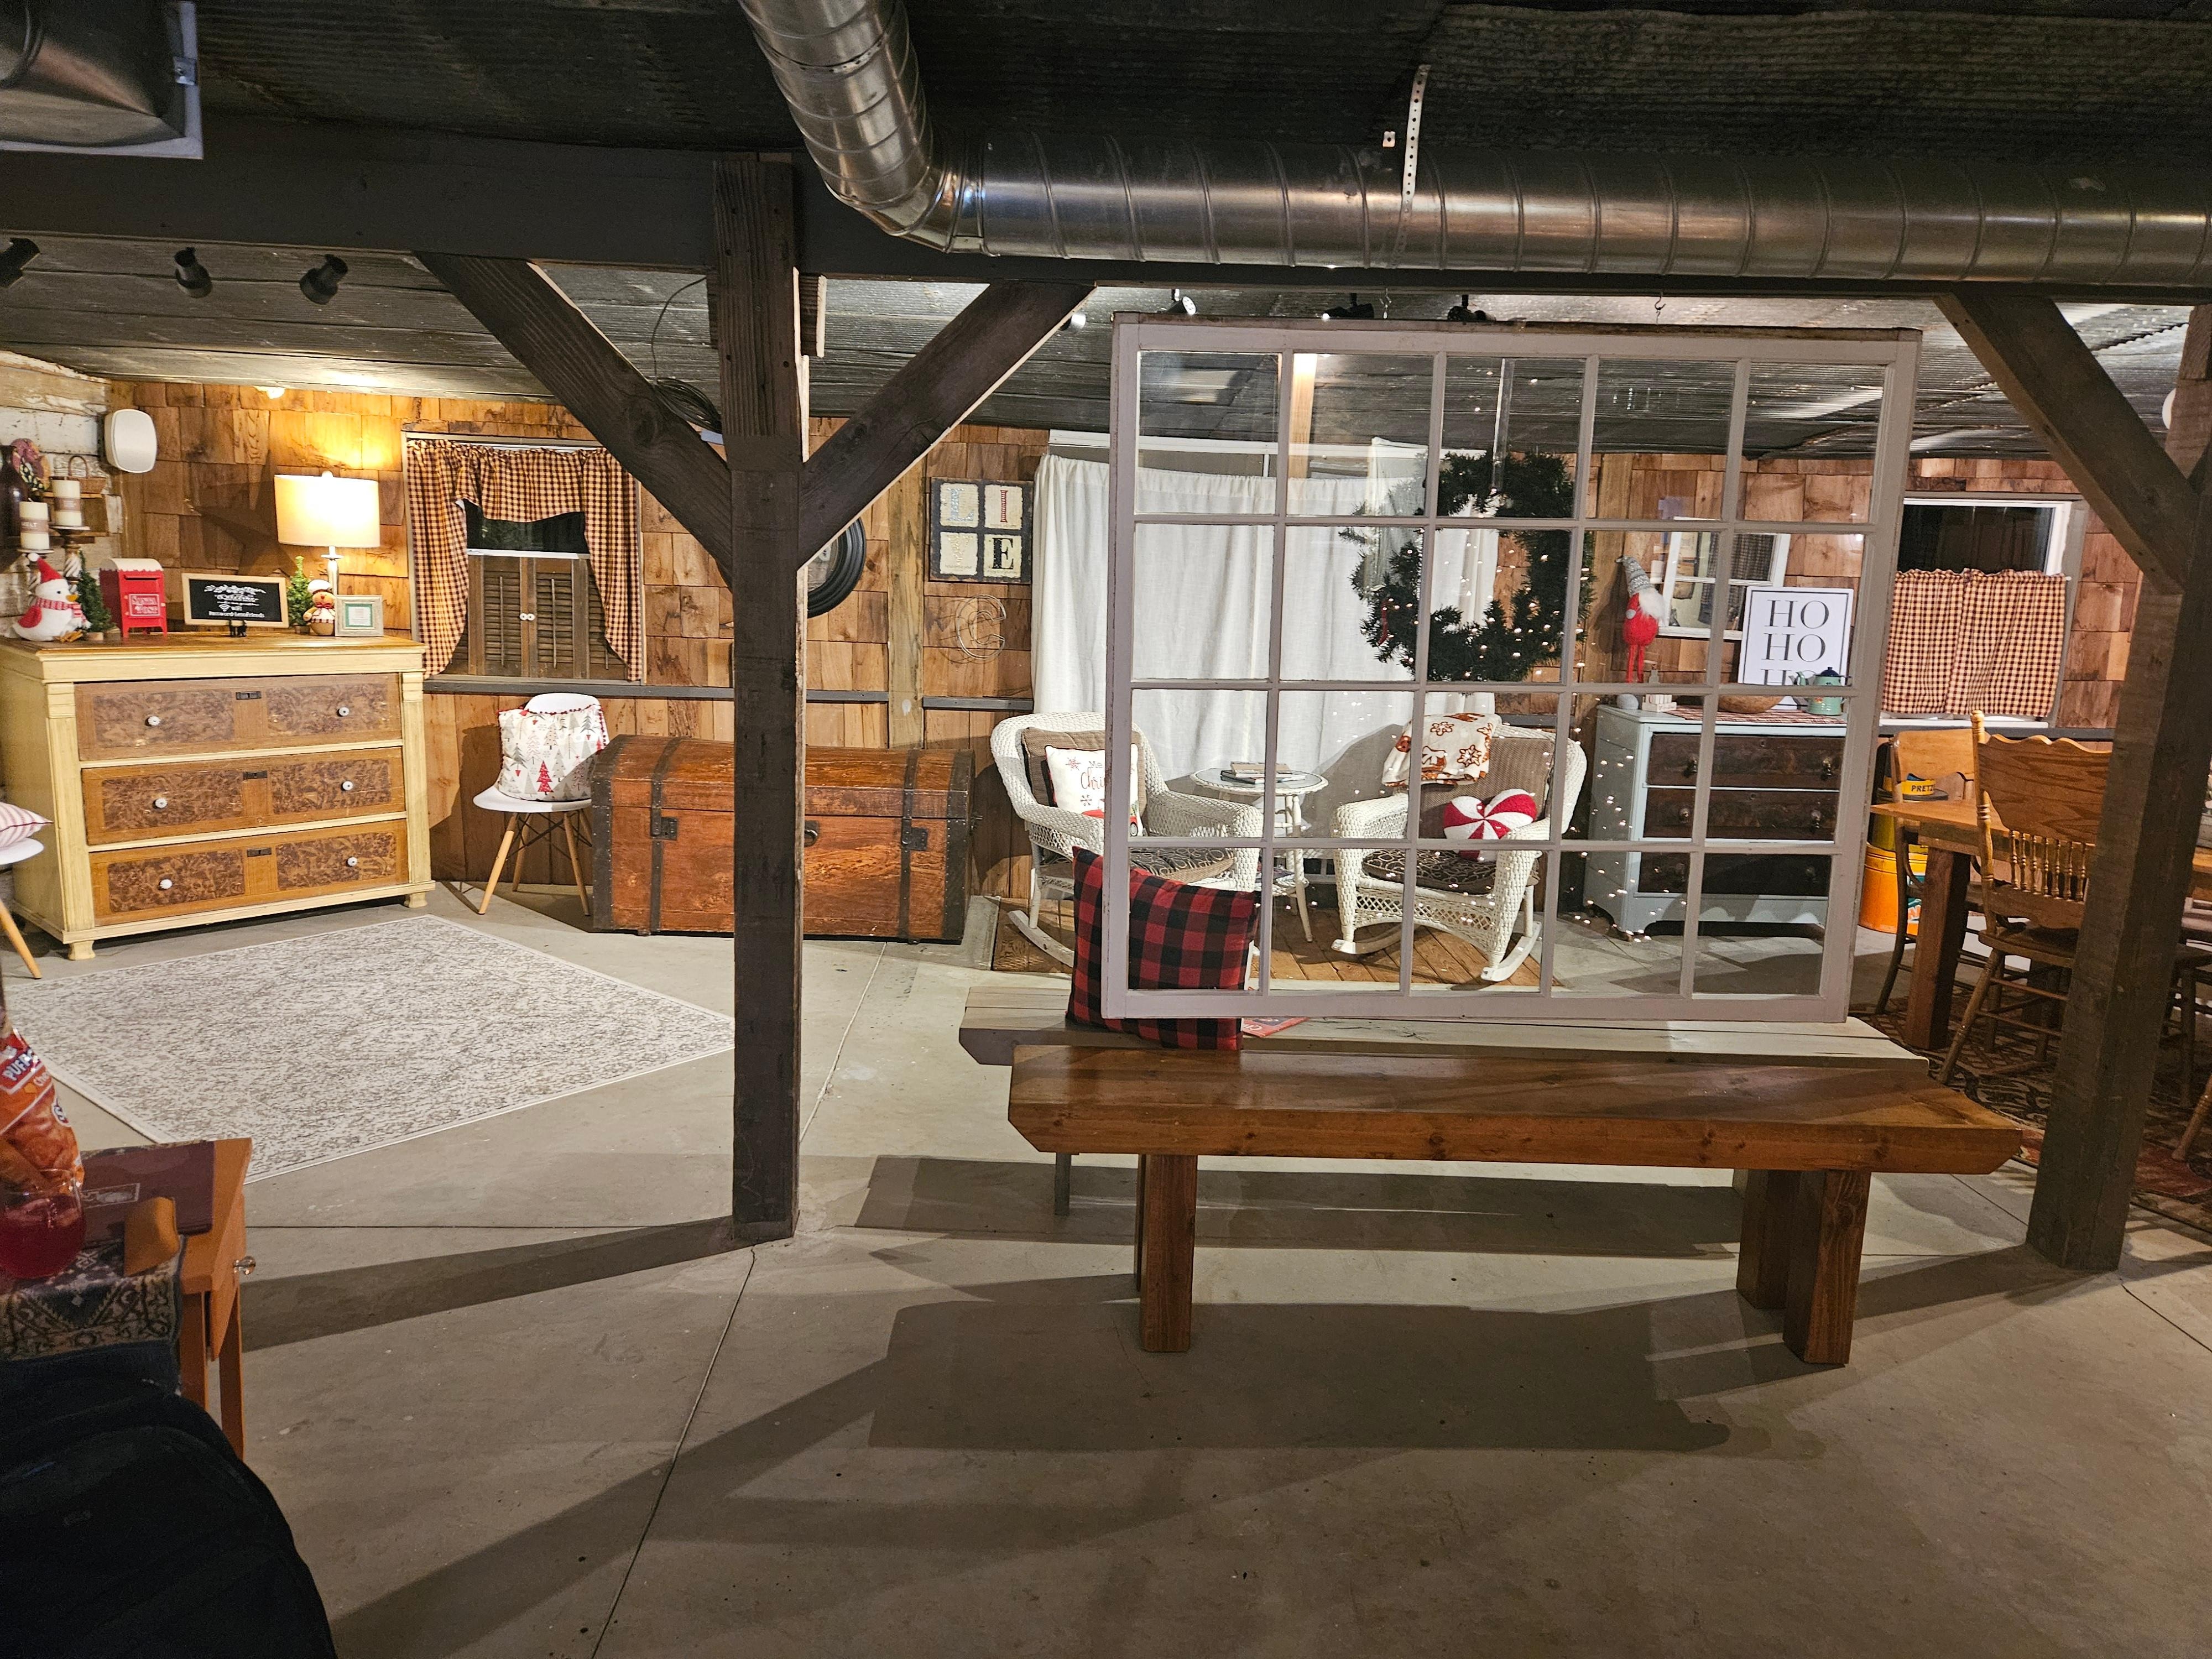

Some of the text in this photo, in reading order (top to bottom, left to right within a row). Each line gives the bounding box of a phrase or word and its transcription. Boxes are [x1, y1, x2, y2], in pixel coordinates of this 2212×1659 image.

[1764, 599, 1829, 629] HO
[1761, 633, 1825, 662] HO
[1081, 766, 1105, 790] Chri
